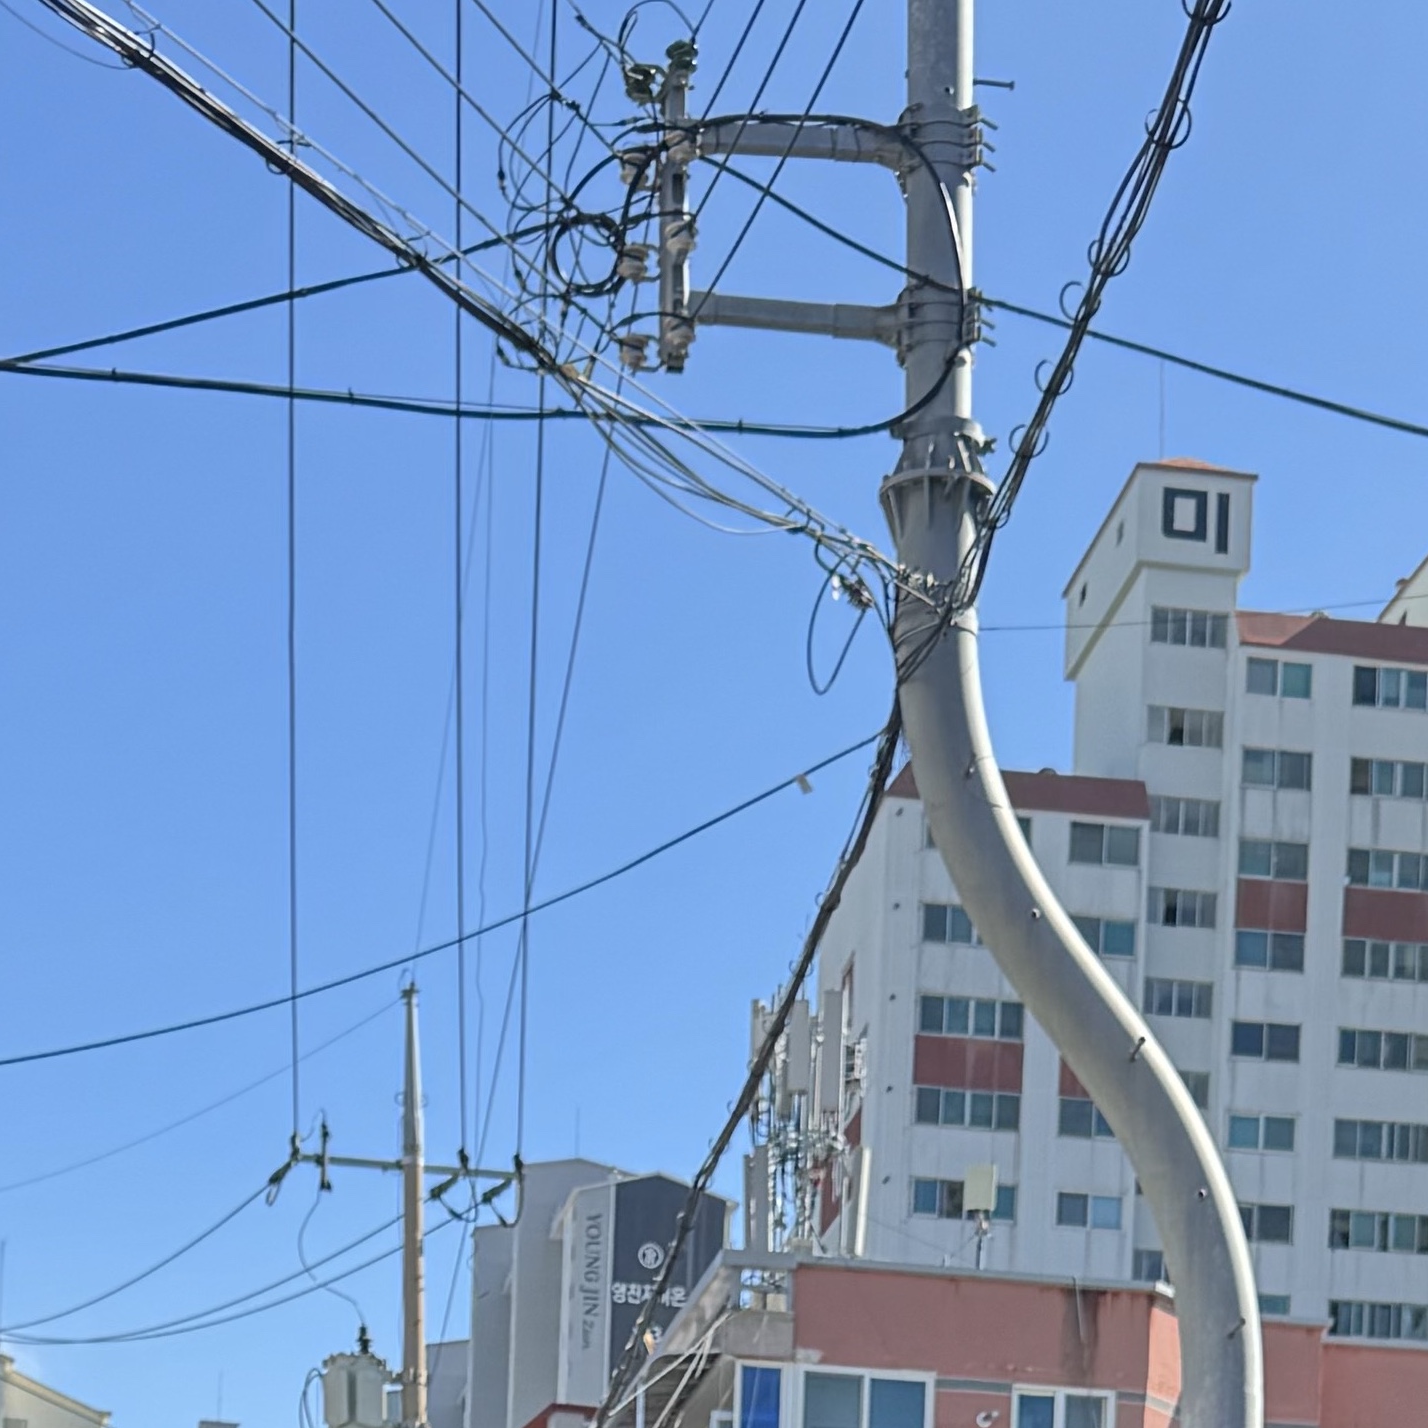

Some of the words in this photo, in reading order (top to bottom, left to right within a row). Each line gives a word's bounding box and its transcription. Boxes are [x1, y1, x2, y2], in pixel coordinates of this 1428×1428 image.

[1162, 486, 1230, 554] 미
[584, 1213, 603, 1283] YOUNG
[578, 1284, 600, 1317] JIN
